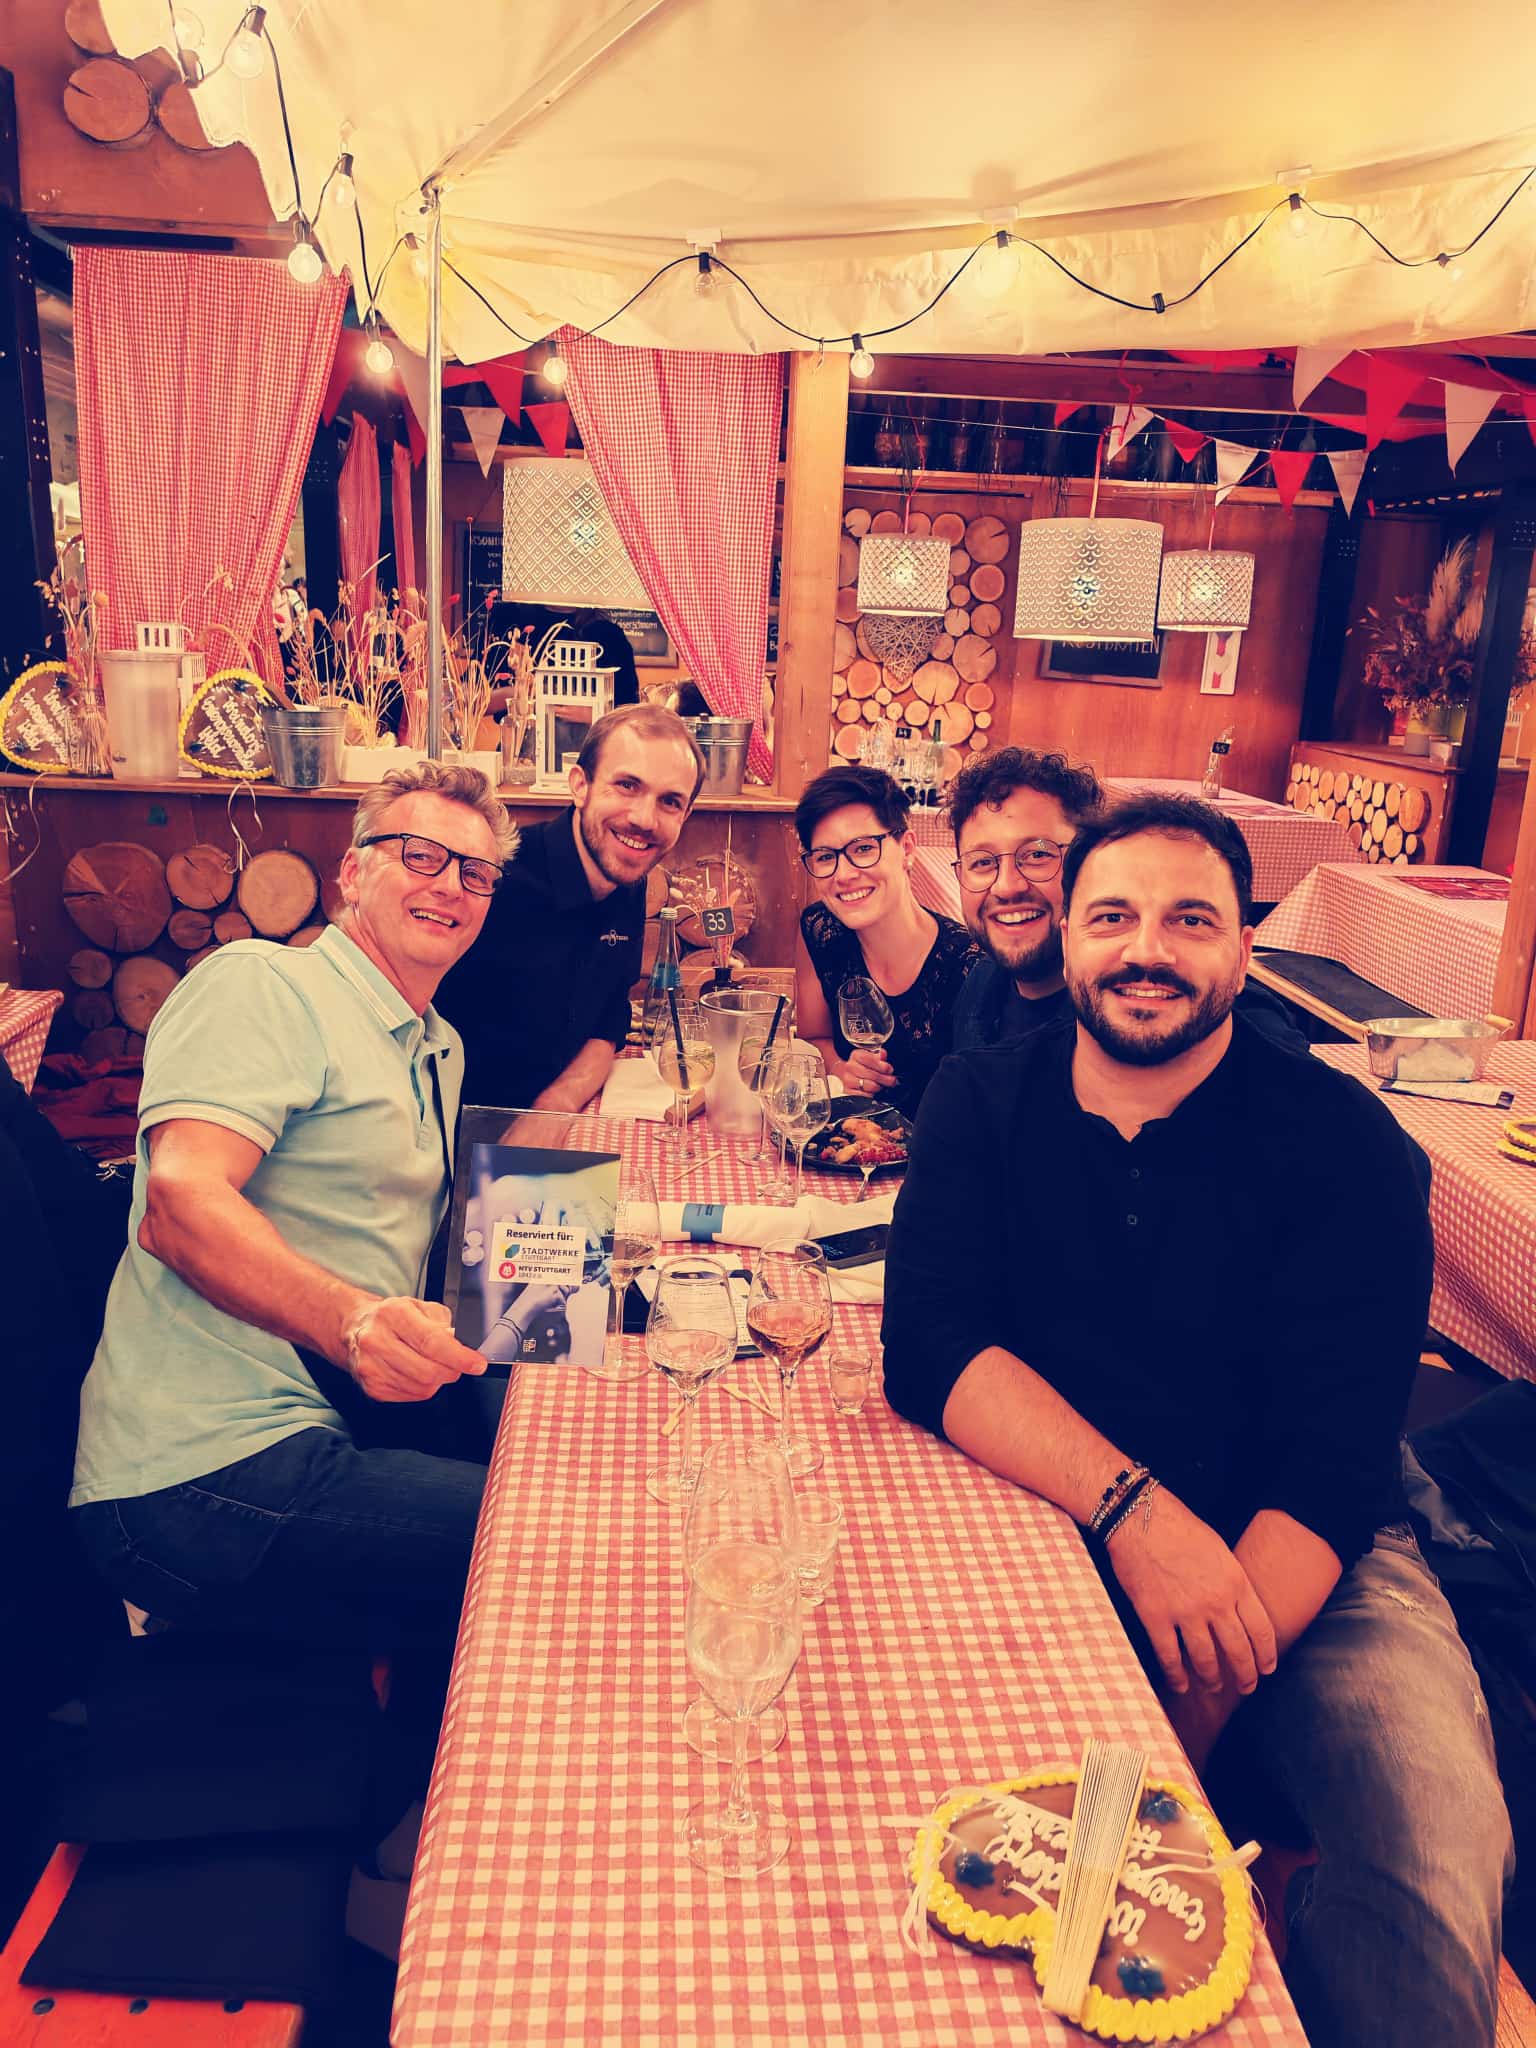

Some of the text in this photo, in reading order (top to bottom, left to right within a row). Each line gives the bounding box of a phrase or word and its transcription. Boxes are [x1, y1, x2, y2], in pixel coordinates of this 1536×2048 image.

[706, 911, 727, 931] 33
[506, 1229, 574, 1241] Reserviert für:
[522, 1247, 579, 1257] STADTWERKE
[534, 1266, 571, 1275] STUTTGART
